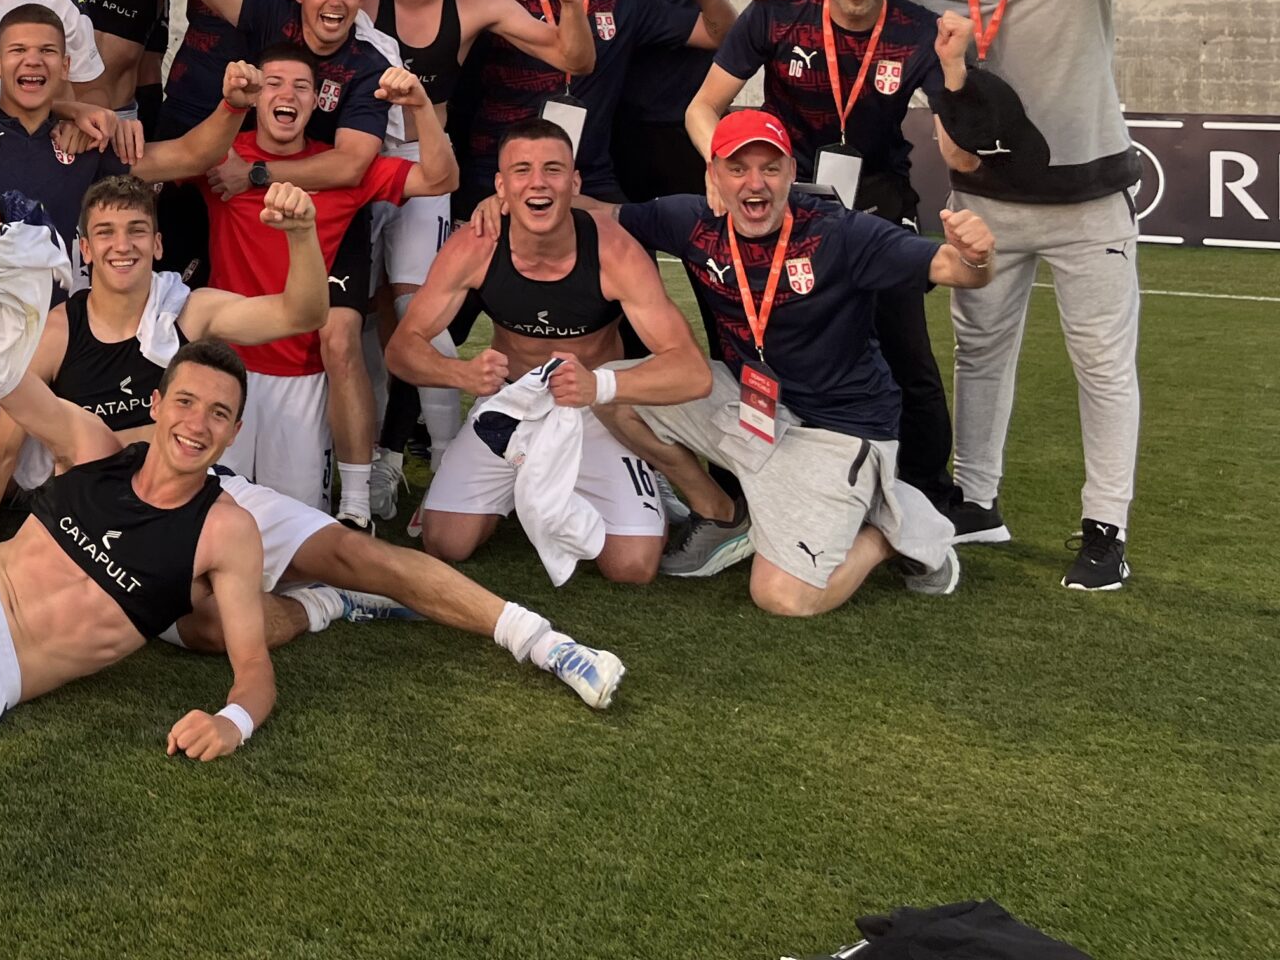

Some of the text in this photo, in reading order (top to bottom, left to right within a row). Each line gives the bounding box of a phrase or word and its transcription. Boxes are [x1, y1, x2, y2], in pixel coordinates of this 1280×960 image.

[789, 59, 804, 78] DG
[1209, 150, 1280, 220] R
[621, 456, 656, 498] 16
[59, 515, 142, 593] CATAPULT
